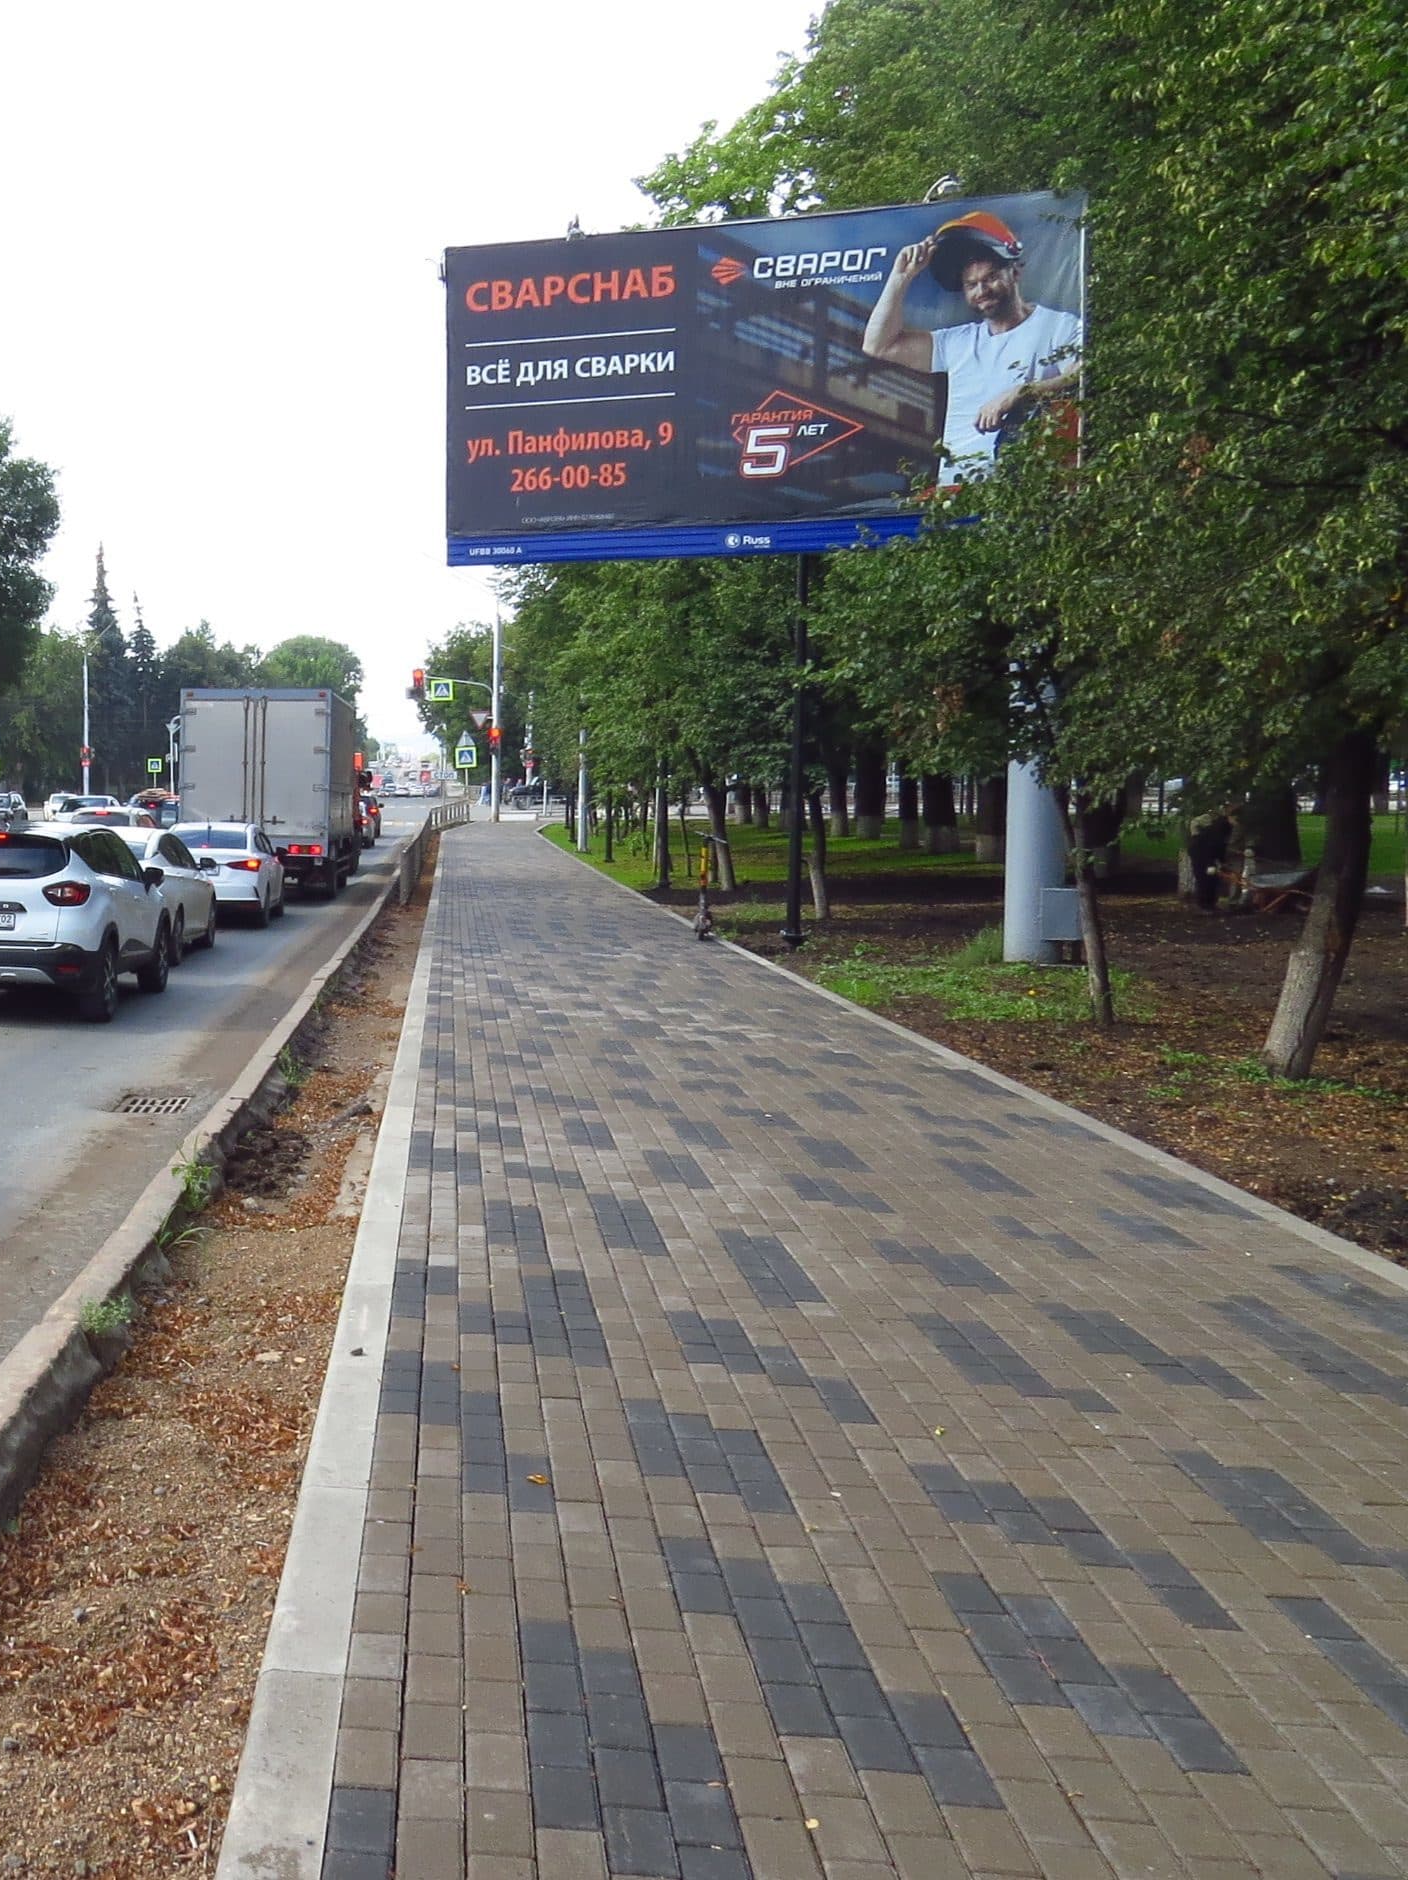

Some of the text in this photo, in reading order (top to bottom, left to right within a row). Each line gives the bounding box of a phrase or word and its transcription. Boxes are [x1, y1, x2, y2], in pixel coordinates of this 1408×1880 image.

[753, 247, 888, 279] СВАРОГ
[465, 264, 676, 313] СВАРСНАБ
[774, 271, 883, 289] ВНЕ ОГРАНИЧЕНИЙ
[466, 350, 675, 386] ВСЁ ДЛЯ СВАРКИ
[731, 409, 814, 425] ГАРАНТИЯ
[466, 421, 675, 464] ул. Панфилова, 9
[739, 422, 829, 479] 5 ЛЕТ
[510, 462, 627, 493] 266-00-85
[742, 535, 771, 545] Russ
